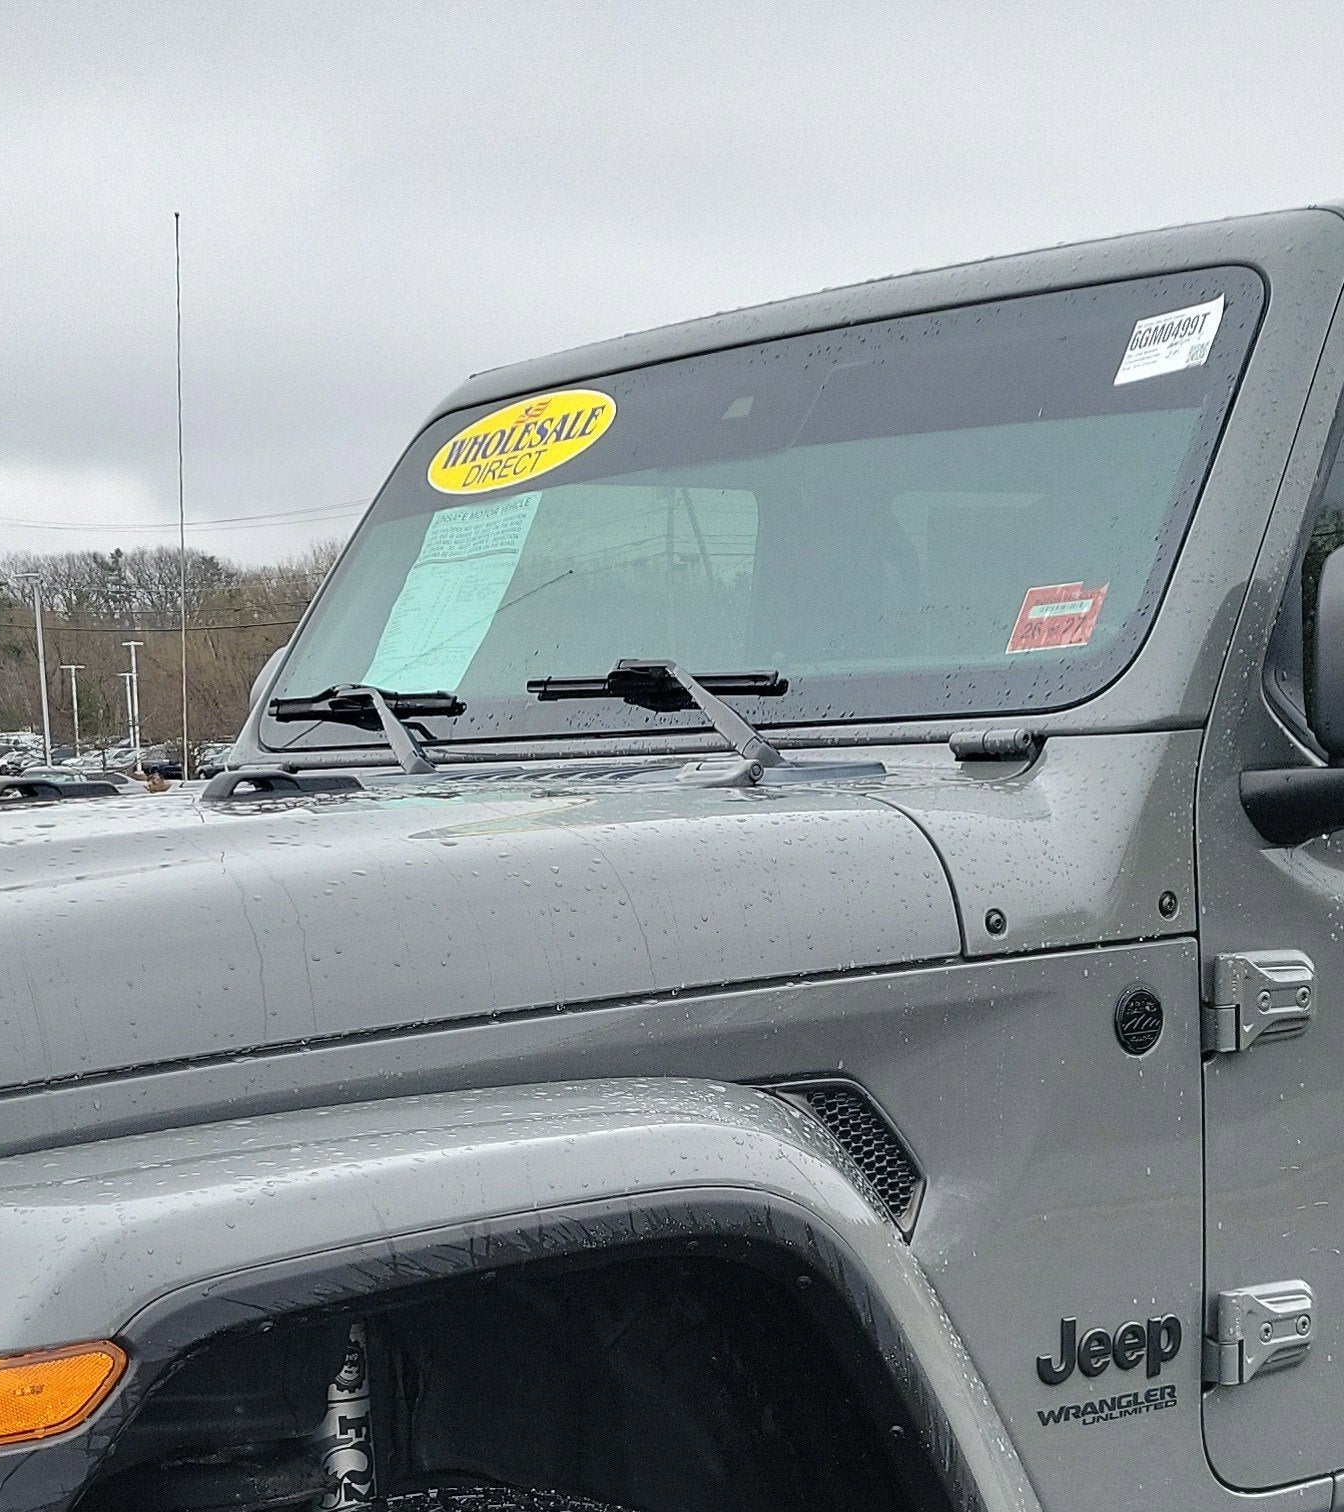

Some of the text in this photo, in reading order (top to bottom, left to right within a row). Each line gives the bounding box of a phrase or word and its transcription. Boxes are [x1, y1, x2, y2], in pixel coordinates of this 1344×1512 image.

[442, 405, 606, 469] WHOLESALE
[462, 449, 548, 487] DIRECT
[1036, 1313, 1182, 1386] Jeep
[1036, 1384, 1178, 1427] WRANGLER
[1082, 1399, 1177, 1426] UNLIMITED
